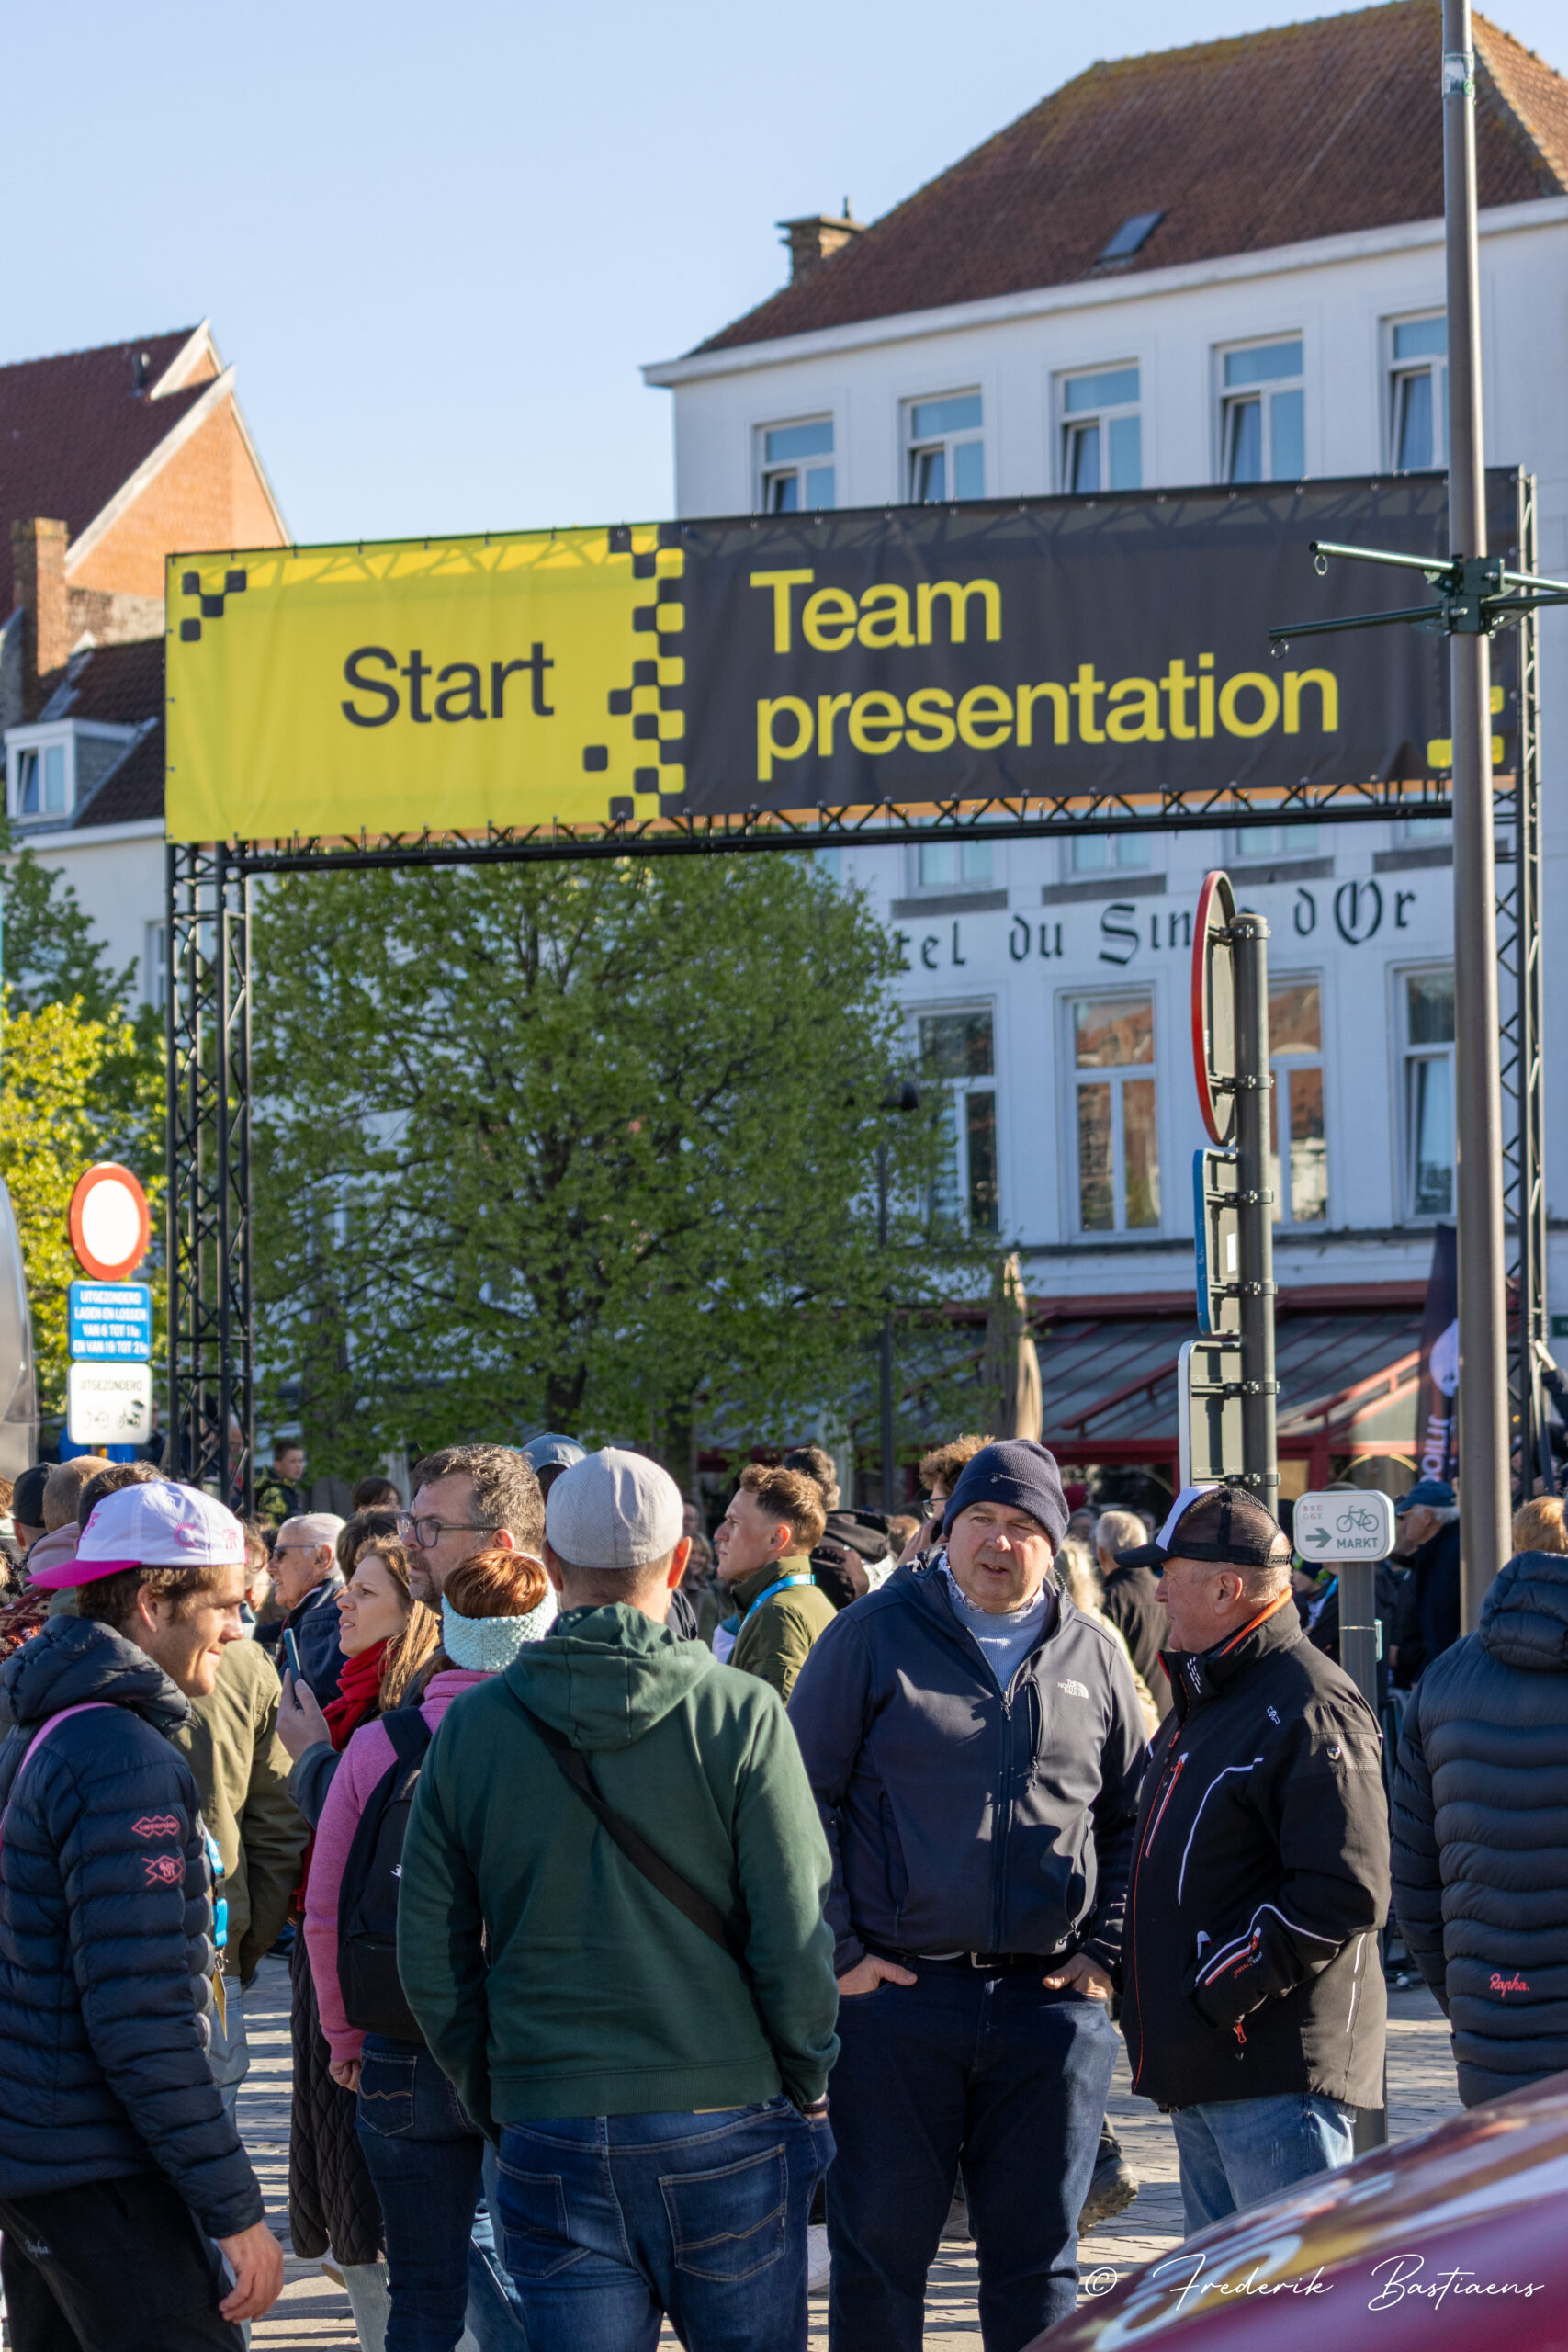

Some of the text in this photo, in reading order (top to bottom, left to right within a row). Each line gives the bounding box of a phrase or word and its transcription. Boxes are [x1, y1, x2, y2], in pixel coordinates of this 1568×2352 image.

[749, 567, 1003, 654] Team
[341, 642, 555, 729] Start
[755, 651, 1339, 782] presentation
[1009, 913, 1064, 962] du
[1098, 904, 1256, 966] Sin
[74, 1306, 147, 1321] LADEN EN LOSSEN
[82, 1323, 100, 1337] VAN
[109, 1324, 126, 1338] TOT
[73, 1340, 85, 1353] EN
[86, 1340, 104, 1353] VAN
[117, 1340, 132, 1354] TOT
[1337, 1537, 1379, 1549] MARKT
